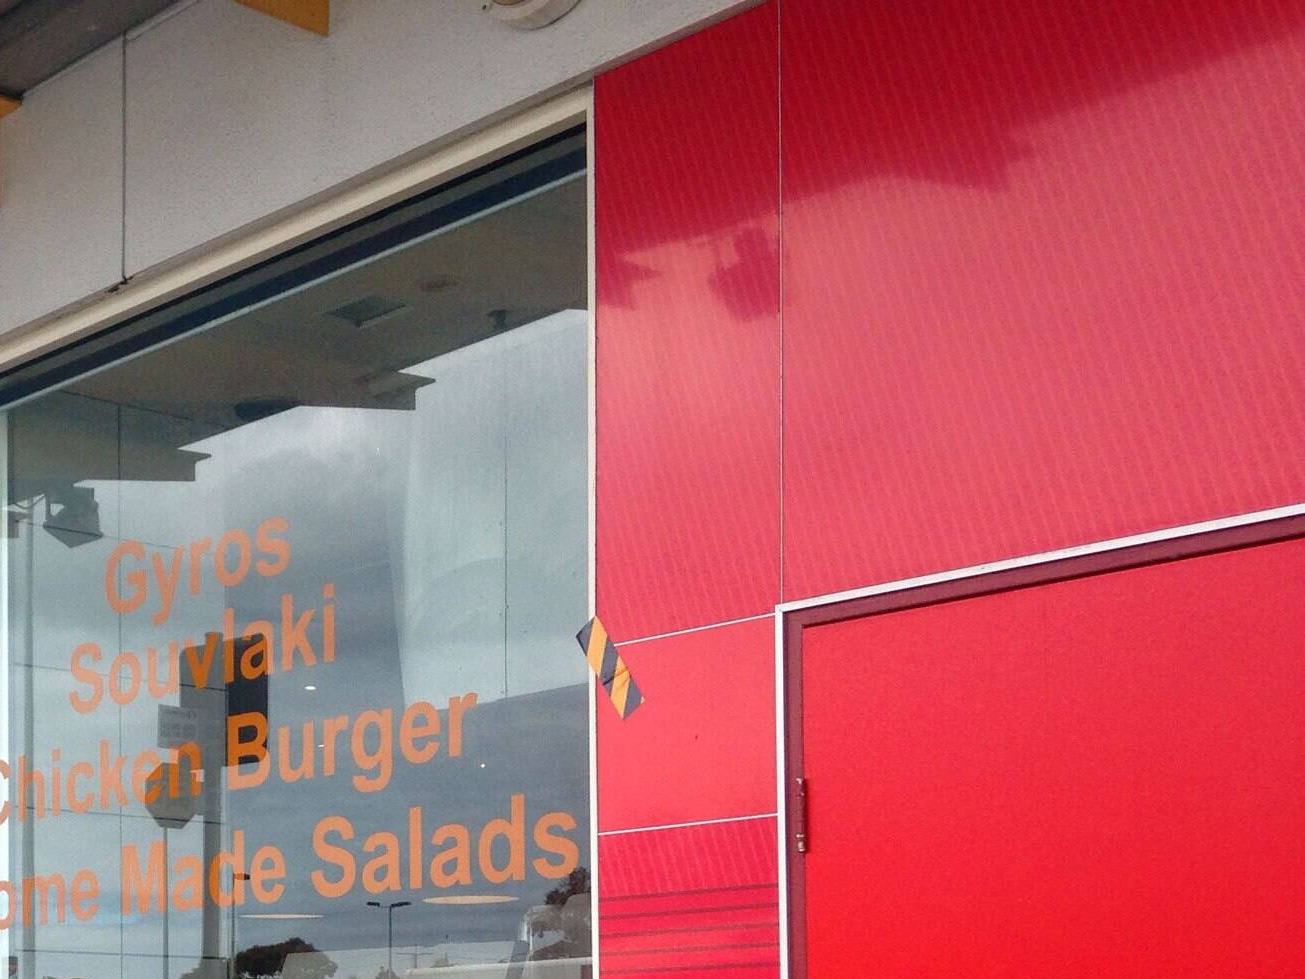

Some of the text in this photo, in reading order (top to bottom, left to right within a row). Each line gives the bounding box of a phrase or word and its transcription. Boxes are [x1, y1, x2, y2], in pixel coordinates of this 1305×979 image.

[104, 516, 292, 625] Gyros
[68, 584, 338, 714] Souvlaki
[226, 691, 479, 794] Burger
[121, 829, 287, 917] Made
[310, 793, 581, 899] Salads
